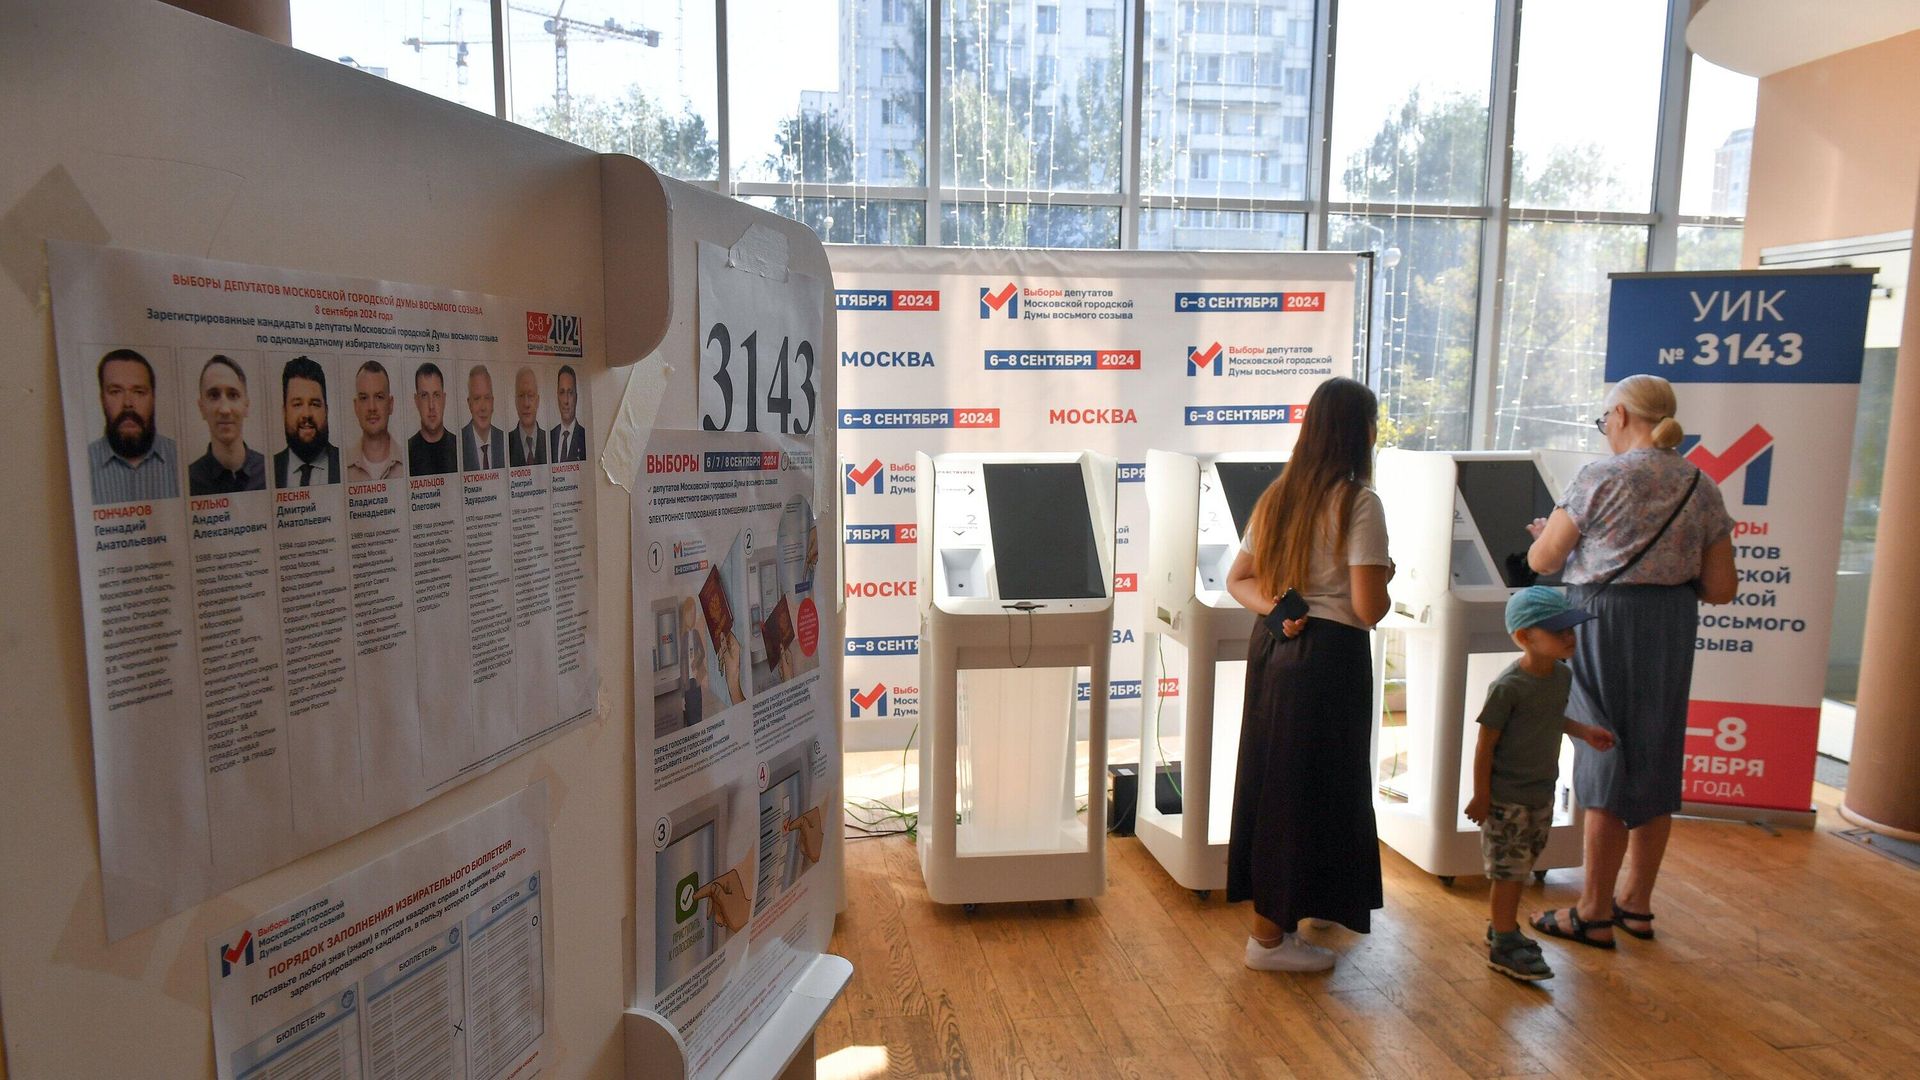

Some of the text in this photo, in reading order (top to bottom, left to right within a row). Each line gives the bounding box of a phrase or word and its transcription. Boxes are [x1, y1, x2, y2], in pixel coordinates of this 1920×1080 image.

[172, 273, 487, 316] ВЫБОРЫ ДЕПУТАТОВ МОСКОВСКОЙ ГОРОДСКОЙ ДУМЫ ВОСЬМОГО СОЗЫВА
[897, 294, 934, 307] 2024
[1023, 287, 1113, 301] Выборы депутатов
[1023, 299, 1134, 312] Московской городской
[1209, 297, 1279, 309] СЕНТЯБРЯ
[1287, 297, 1320, 308] 2024
[1689, 289, 1787, 323] УИК
[314, 304, 393, 322] 8 сентября 2024 года
[1023, 311, 1134, 322] Думы восьмого созыва
[146, 307, 255, 327] Зарегистрированные
[256, 318, 306, 332] кандидаты
[307, 321, 313, 329] в
[313, 322, 352, 335] депутаты
[354, 324, 397, 337] Московской
[397, 328, 430, 342] городской
[430, 330, 450, 342] Думы
[450, 332, 478, 344] восьмого
[547, 314, 580, 347] 2024
[256, 335, 268, 344] по
[270, 334, 344, 351] одномандатному
[345, 338, 404, 353] избирательному
[404, 343, 425, 355] округу
[436, 344, 441, 353] 3
[1229, 345, 1314, 357] Выборы депутатов
[1657, 332, 1805, 366] № 3143
[841, 351, 937, 367] МОСКВА
[1020, 353, 1092, 366] СЕНТЯБРЯ
[1101, 354, 1136, 367] 2024
[1229, 355, 1333, 368] Московской городской
[702, 321, 817, 436] 3143
[1228, 367, 1332, 378] Думы восьмого созыва
[875, 412, 949, 425] СЕНТЯБРЯ
[958, 412, 994, 424] 2024
[1048, 408, 1138, 425] МОСКВА
[1216, 408, 1285, 421] СЕНТЯБРЯ
[646, 453, 700, 474] ВЫБОРЫ
[730, 455, 761, 467] СЕНТЯБРЯ
[763, 455, 777, 466] 2024
[890, 464, 917, 473] Выбо
[463, 472, 500, 484] УСТЮЖАНИН
[510, 468, 532, 479] ФРОЛОВ
[347, 483, 388, 497] СУЛТАНОВ
[410, 477, 446, 491] УДАЛЬЦОВ
[510, 479, 533, 492] Дмитрий
[552, 478, 566, 488] Антон
[552, 484, 579, 496] Николаевич
[653, 484, 680, 495] депутатов
[680, 481, 710, 492] Московской
[276, 490, 311, 503] ЛЕСНЯК
[410, 489, 442, 502] Анатолий
[464, 486, 483, 497] Роман
[510, 488, 548, 501] Владимирович
[190, 498, 230, 512] ГУЛЬКО
[347, 496, 389, 509] Владислав
[464, 495, 498, 508] Эдуардович
[658, 495, 677, 507] органы
[676, 493, 700, 504] местного
[92, 504, 153, 521] ГОНЧАРОВ
[276, 502, 317, 518] Дмитрий
[348, 507, 397, 521] Геннадьевич
[411, 501, 441, 514] Олегович
[191, 510, 231, 527] Андрей
[276, 515, 332, 529] Анатольевич
[648, 511, 685, 525] ЭЛЕКТРОННОЕ
[684, 507, 718, 521] ГОЛОСОВАНИЕ
[94, 519, 147, 537] Геннадий
[192, 522, 268, 541] Александрович
[846, 527, 917, 541] ТЯБРЯ 20
[95, 535, 168, 553] Анатольевич
[745, 533, 752, 551] 2
[653, 548, 659, 566] 1
[1115, 576, 1132, 588] 24
[1695, 637, 1754, 653] зыва
[893, 687, 919, 696] Выбо
[1683, 753, 1765, 778] ТЯБРЯ
[759, 767, 765, 782] 4
[1693, 780, 1745, 798] ГОДА
[657, 822, 666, 842] 3
[268, 838, 512, 979] ПОРЯДОК ЗАПОЛНЕНИЯ ИЗБИРАТЕЛЬНОГО БЮЛЛЕТЕНЯ
[490, 889, 521, 914] БЮЛЛЕТЕНЬ
[257, 898, 329, 938] Выборы депутатов
[258, 900, 345, 948] Московской городской
[250, 974, 298, 1006] Поставьте
[298, 956, 328, 982] любой
[328, 947, 348, 967] знак
[347, 933, 375, 959] (знаки)
[381, 916, 406, 940] пустом
[406, 899, 437, 924] квадрате
[437, 887, 460, 908] справа
[459, 882, 468, 893] от
[467, 865, 493, 889] фамилии
[491, 857, 509, 874] только
[508, 847, 527, 867] одного
[259, 910, 346, 961] Думы восьмого созыва
[289, 944, 375, 999] зарегистрированного
[375, 922, 415, 954] кандидата,
[420, 906, 444, 932] пользу
[443, 892, 471, 915] которого
[470, 879, 489, 900] сделан
[489, 869, 507, 889] выбор
[397, 943, 438, 972] БЮЛЛЕТЕНЬ
[275, 1009, 327, 1045] БЮЛЛЕТЕНЬ
